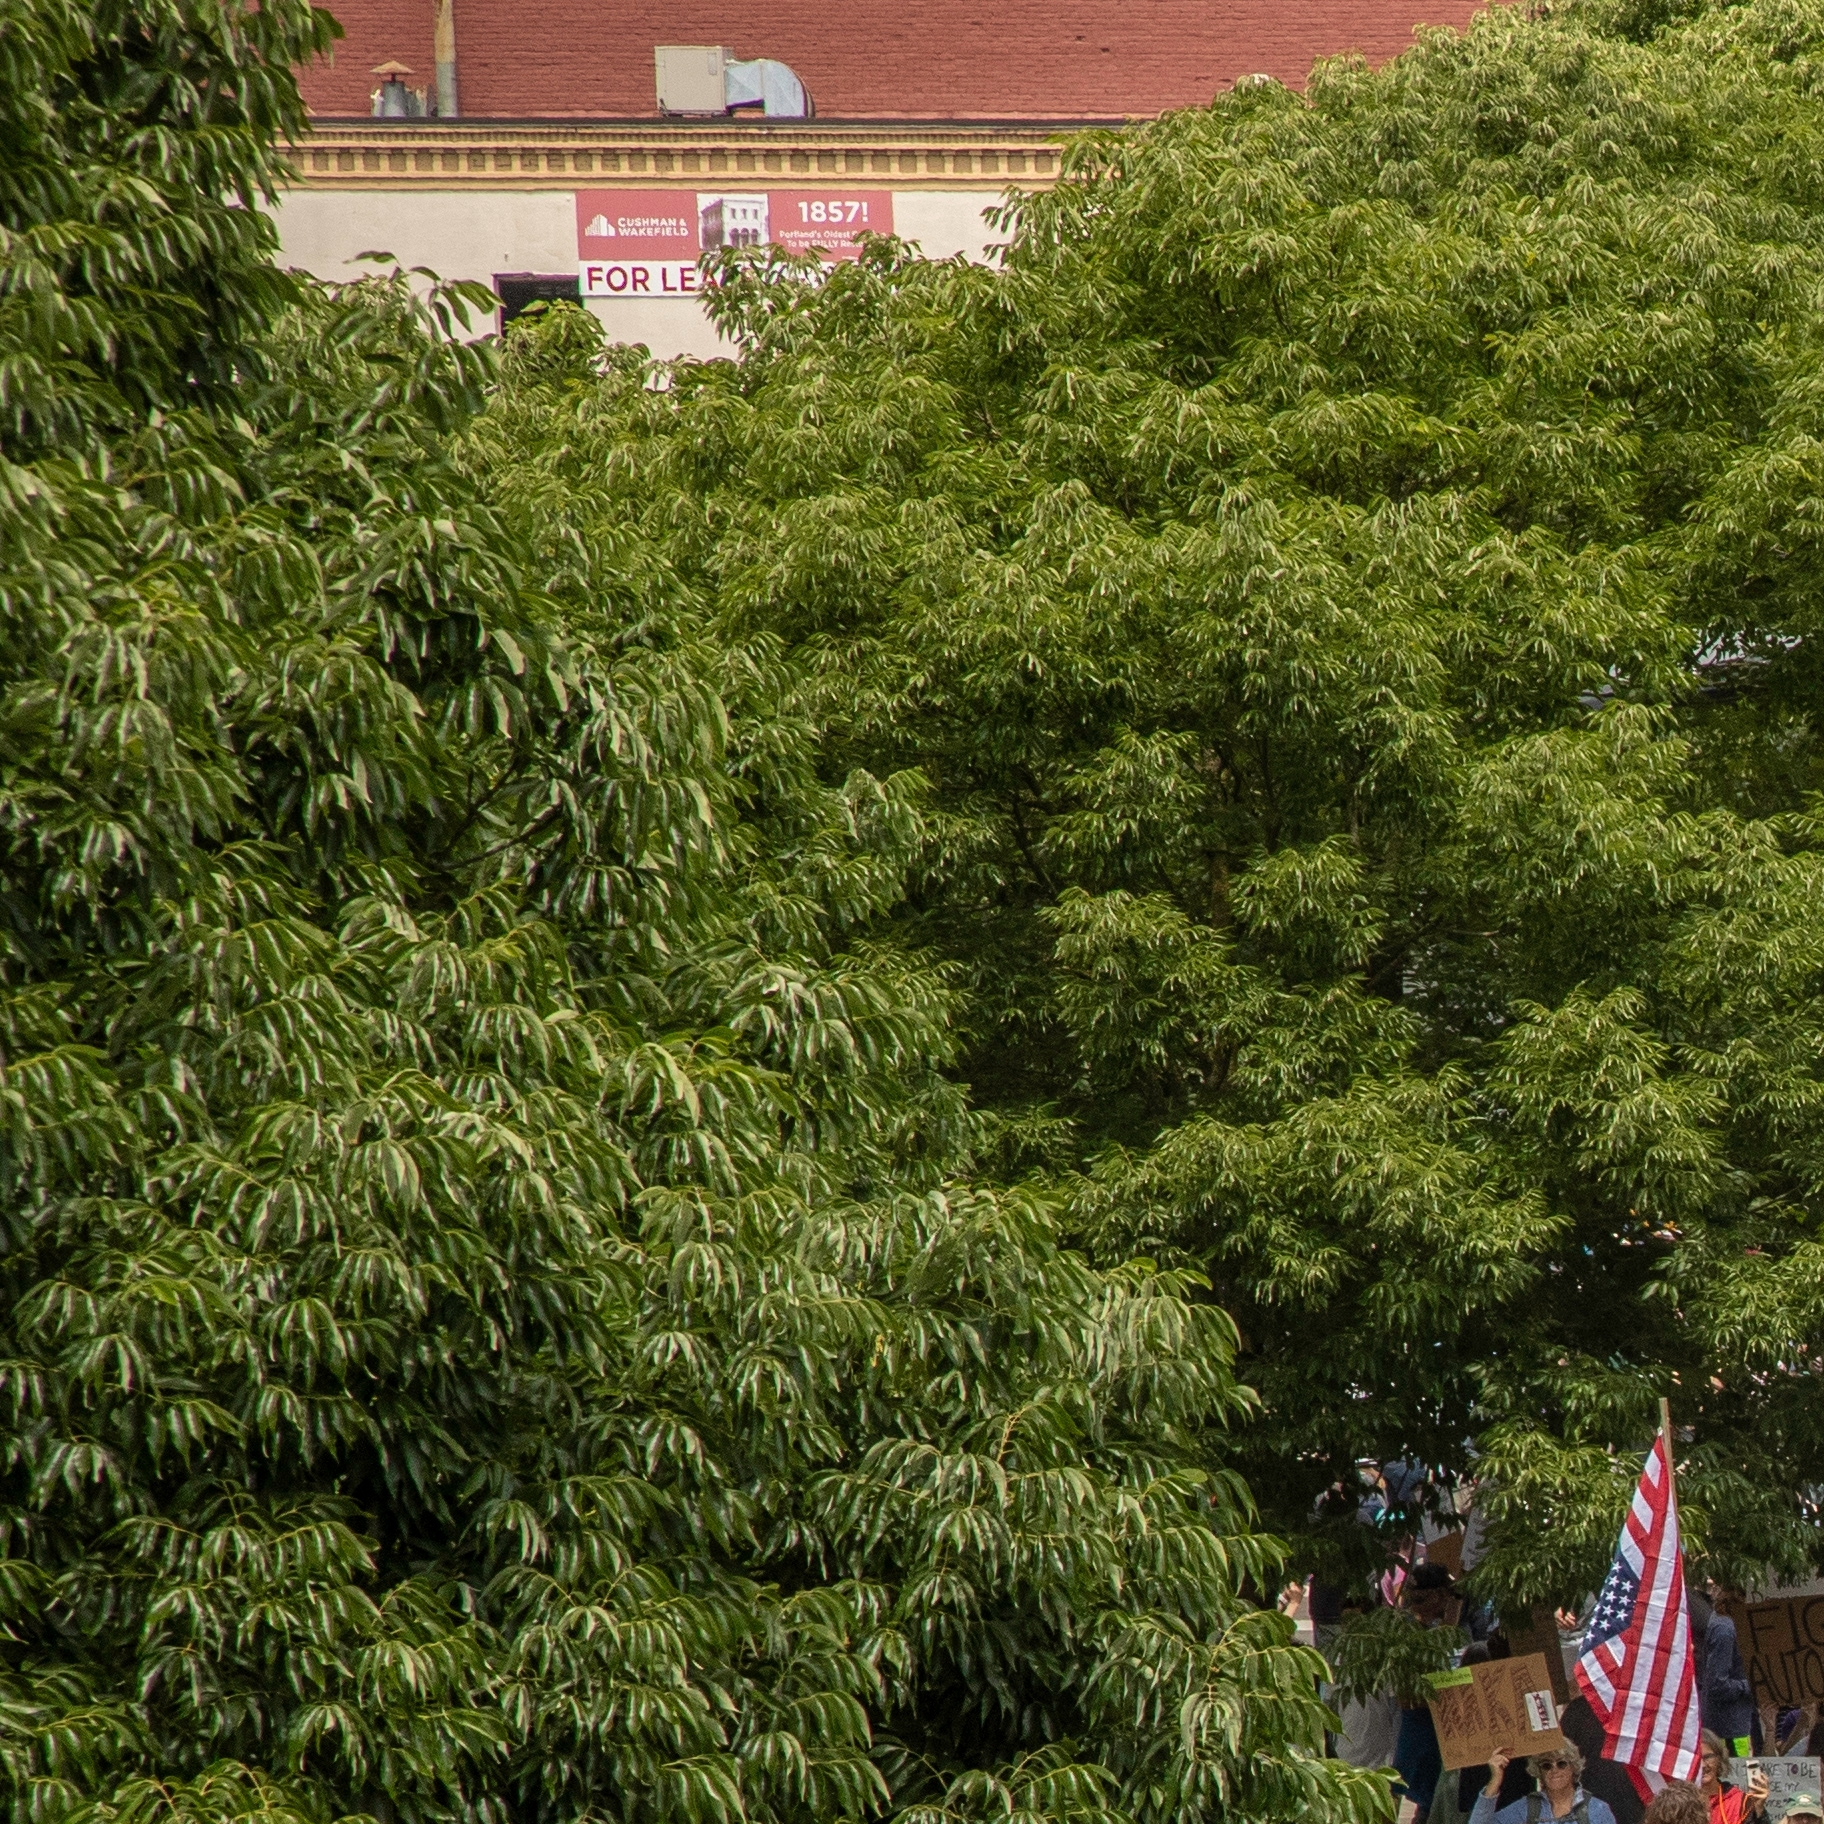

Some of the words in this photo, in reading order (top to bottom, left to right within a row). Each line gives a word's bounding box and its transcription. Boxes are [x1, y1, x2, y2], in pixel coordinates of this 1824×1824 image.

[798, 201, 869, 224] 1857!
[618, 217, 675, 227] CUSHMAN
[679, 217, 687, 226] &
[618, 228, 688, 237] WAKEFIELD
[588, 267, 651, 292] FOR
